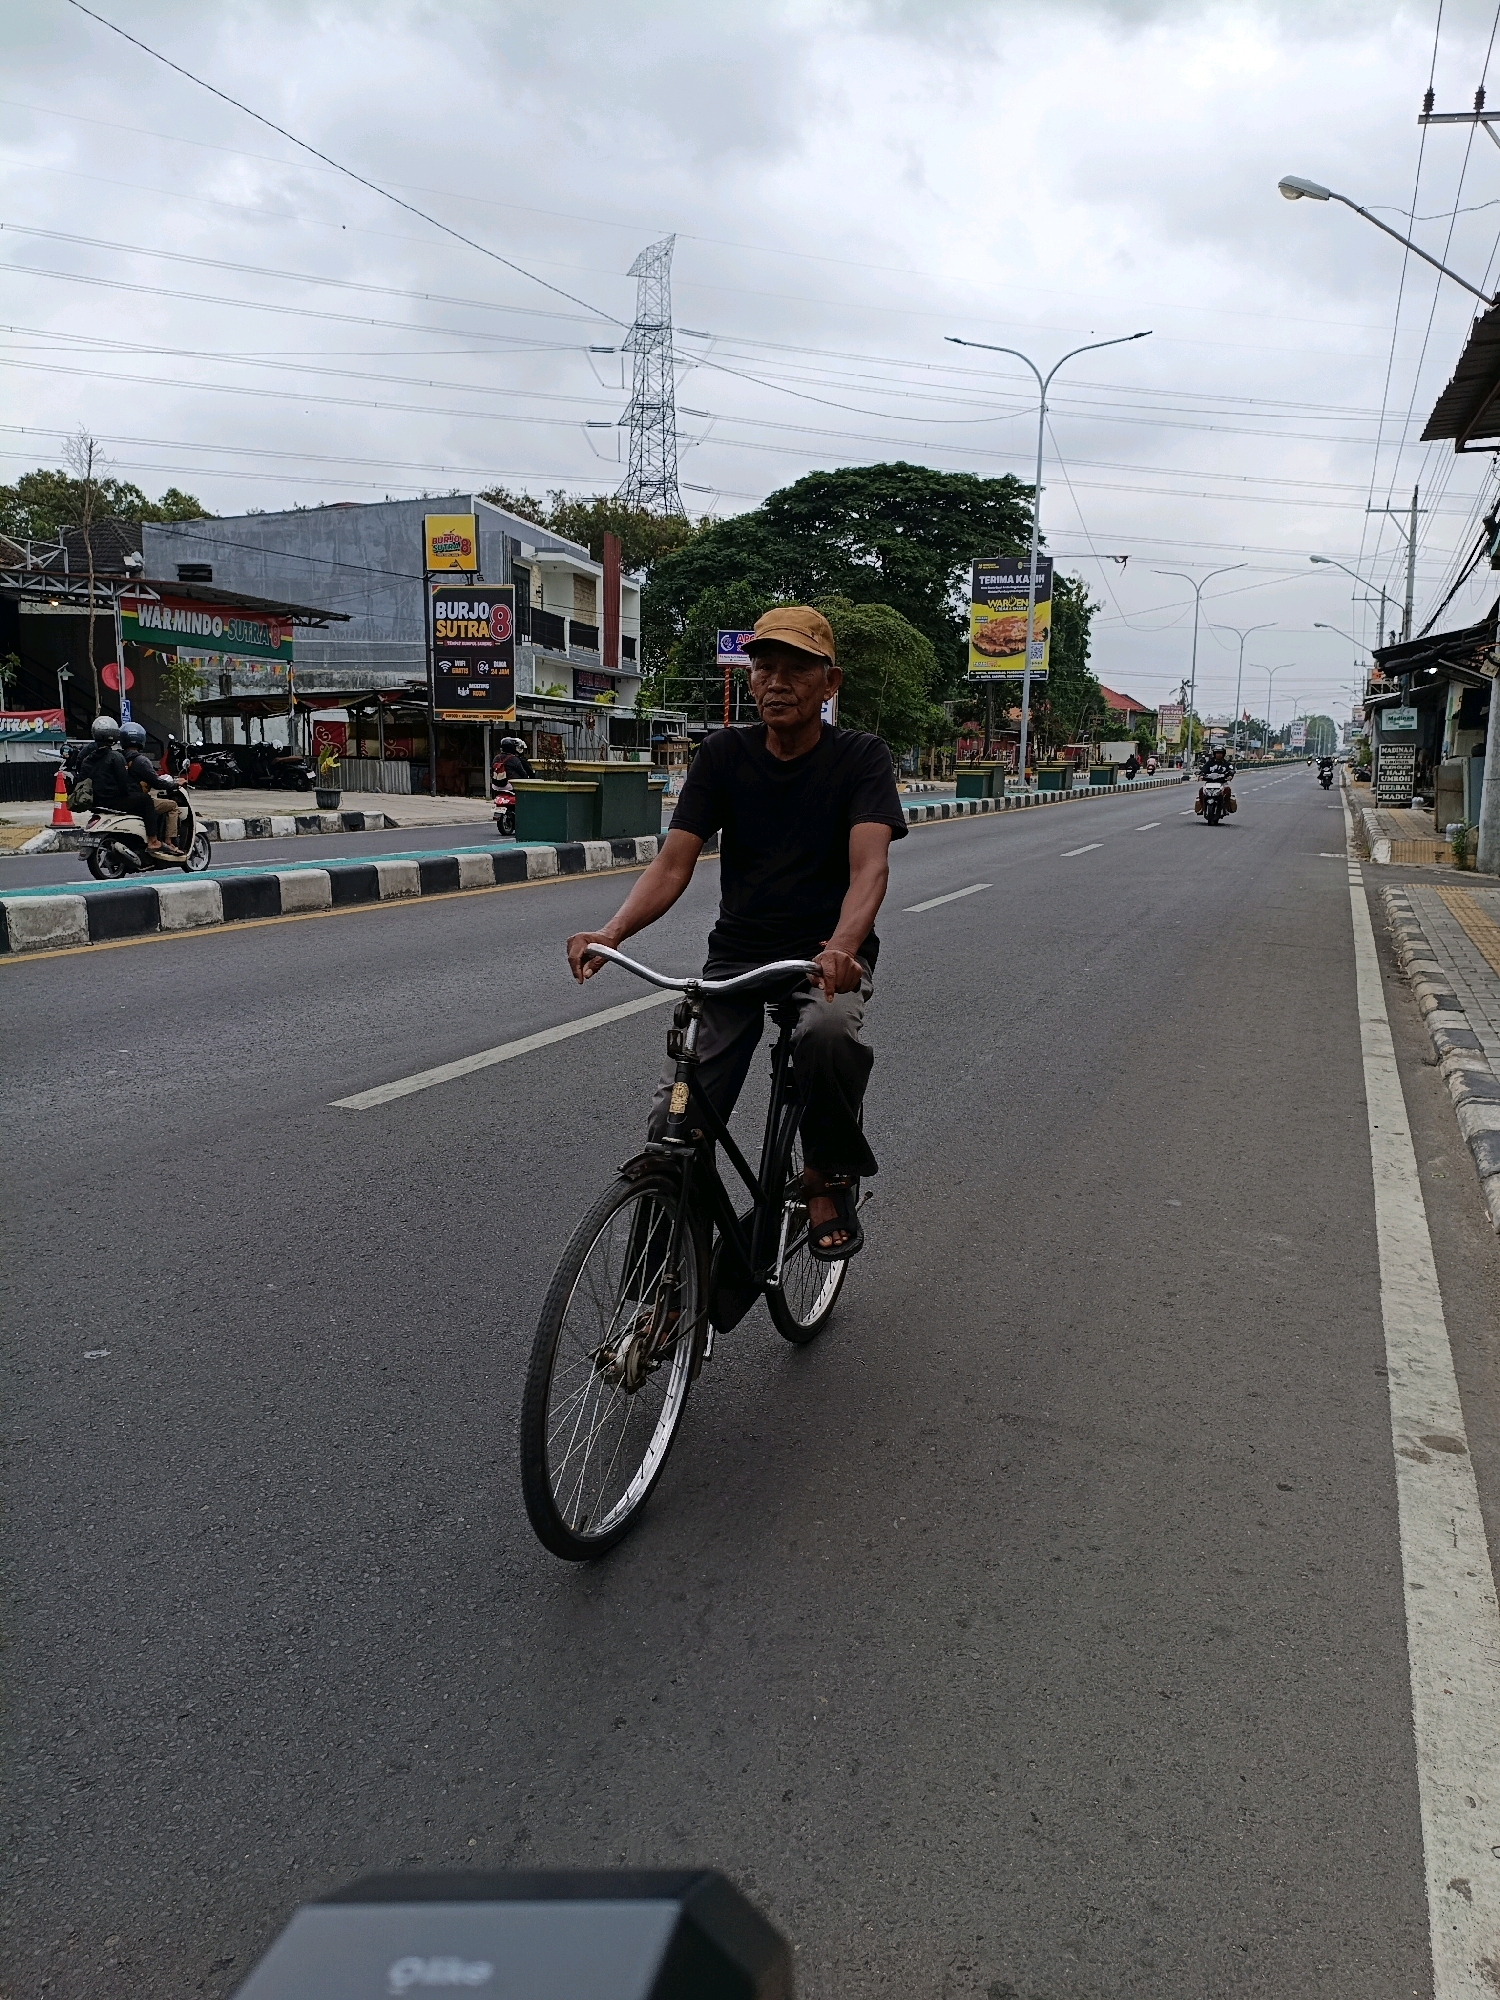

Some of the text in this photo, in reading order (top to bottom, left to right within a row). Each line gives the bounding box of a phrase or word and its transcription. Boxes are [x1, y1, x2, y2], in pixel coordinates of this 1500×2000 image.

[432, 535, 461, 545] BURJO
[461, 538, 472, 556] 8
[979, 573, 1045, 585] TERIMA KAIH
[435, 601, 490, 619] BURJO
[137, 603, 281, 649] WARMINDO SUTRA 8
[435, 603, 513, 642] SUTRA 8
[34, 717, 44, 734] 8
